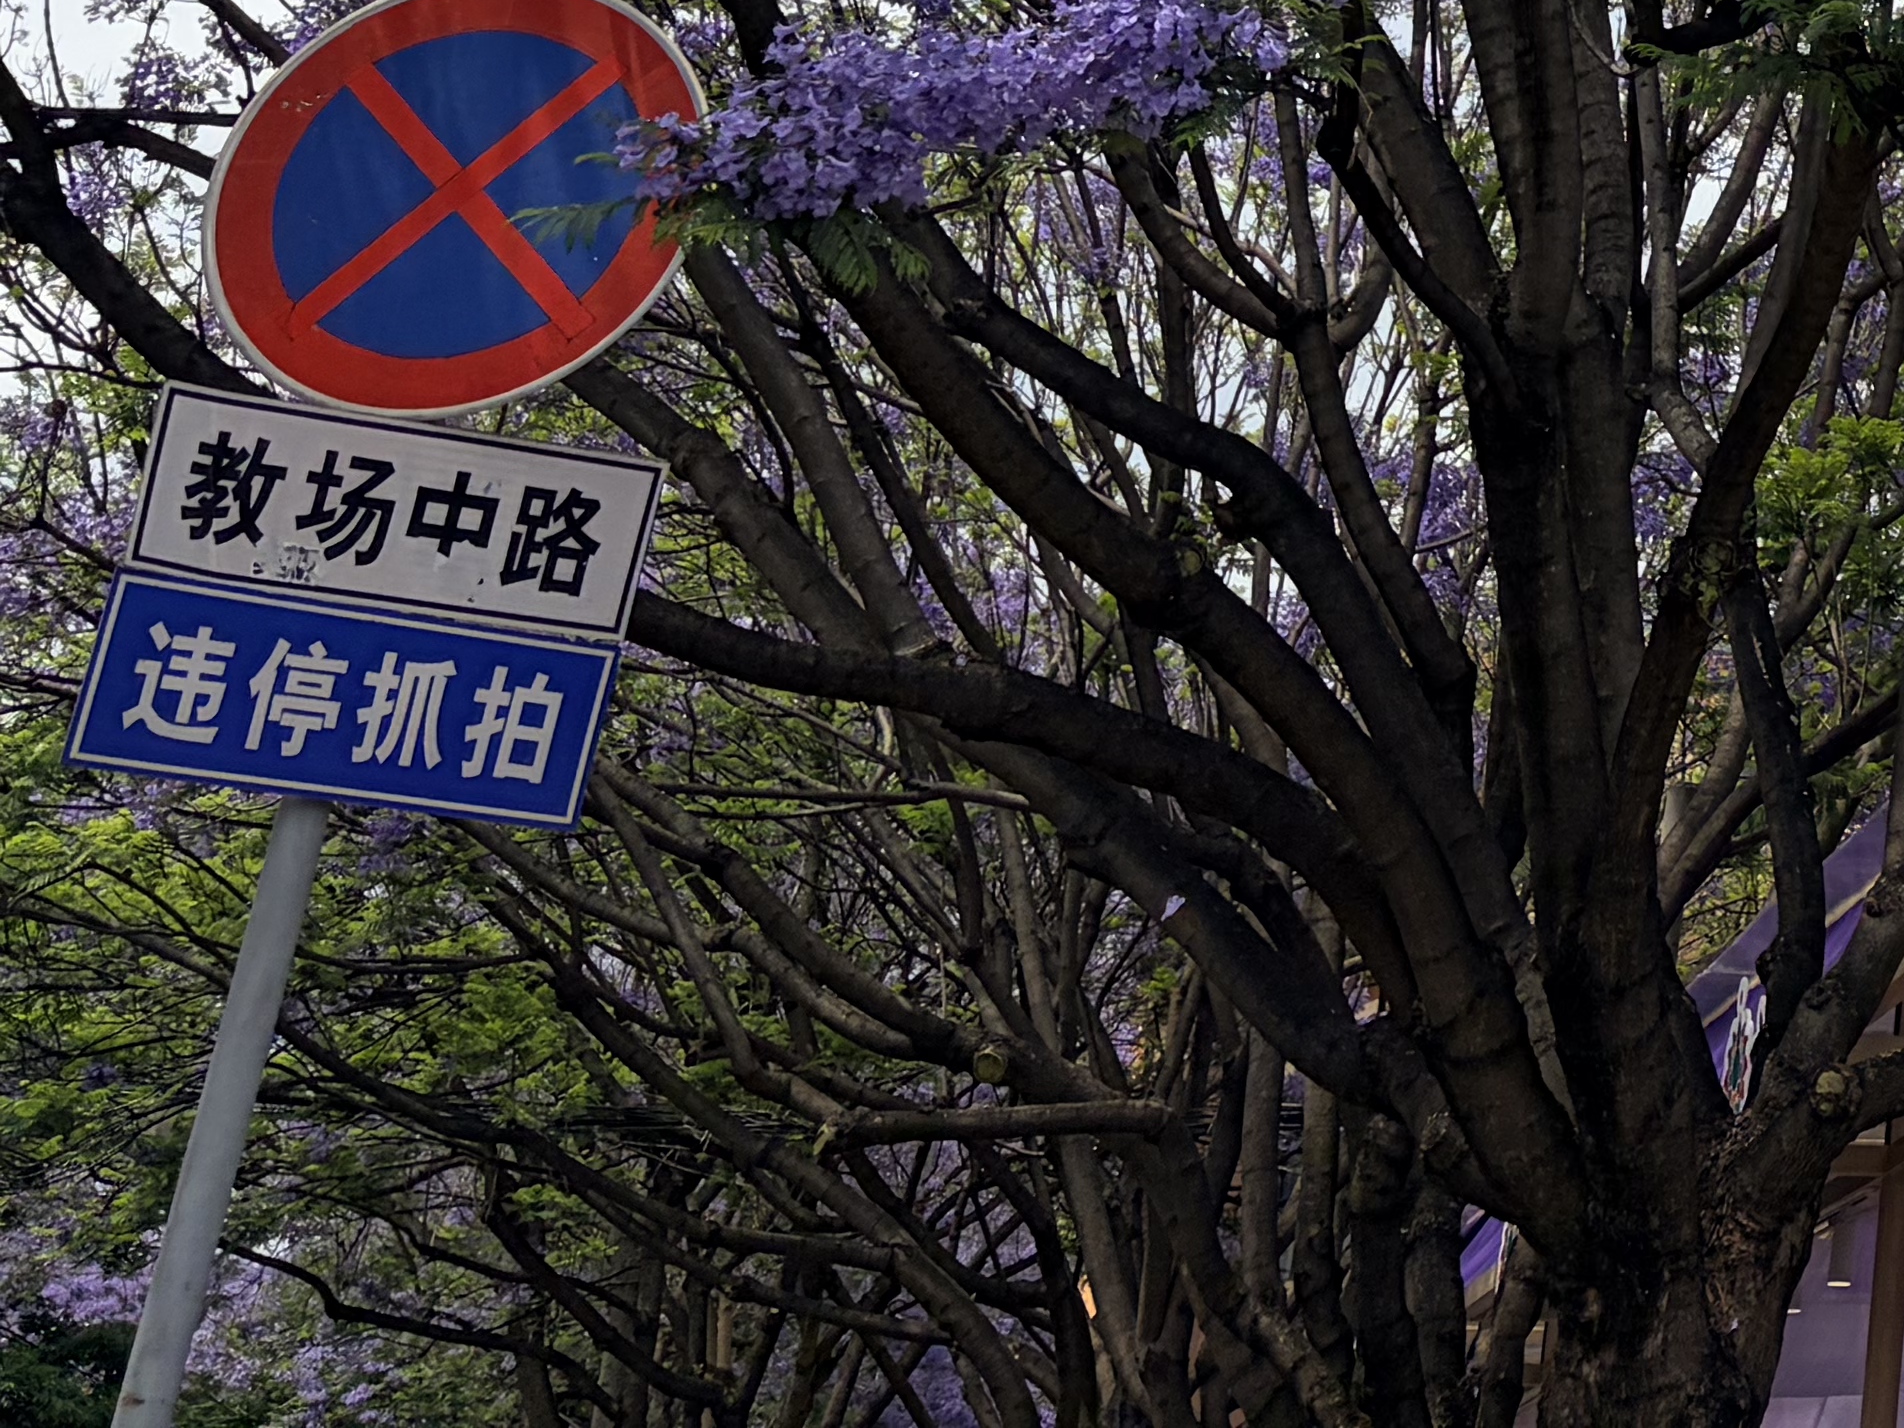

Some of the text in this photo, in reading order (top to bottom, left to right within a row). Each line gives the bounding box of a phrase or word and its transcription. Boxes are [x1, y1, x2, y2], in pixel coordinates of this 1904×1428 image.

[181, 431, 601, 597] 教场中路
[122, 621, 563, 785] 违停抓拍
